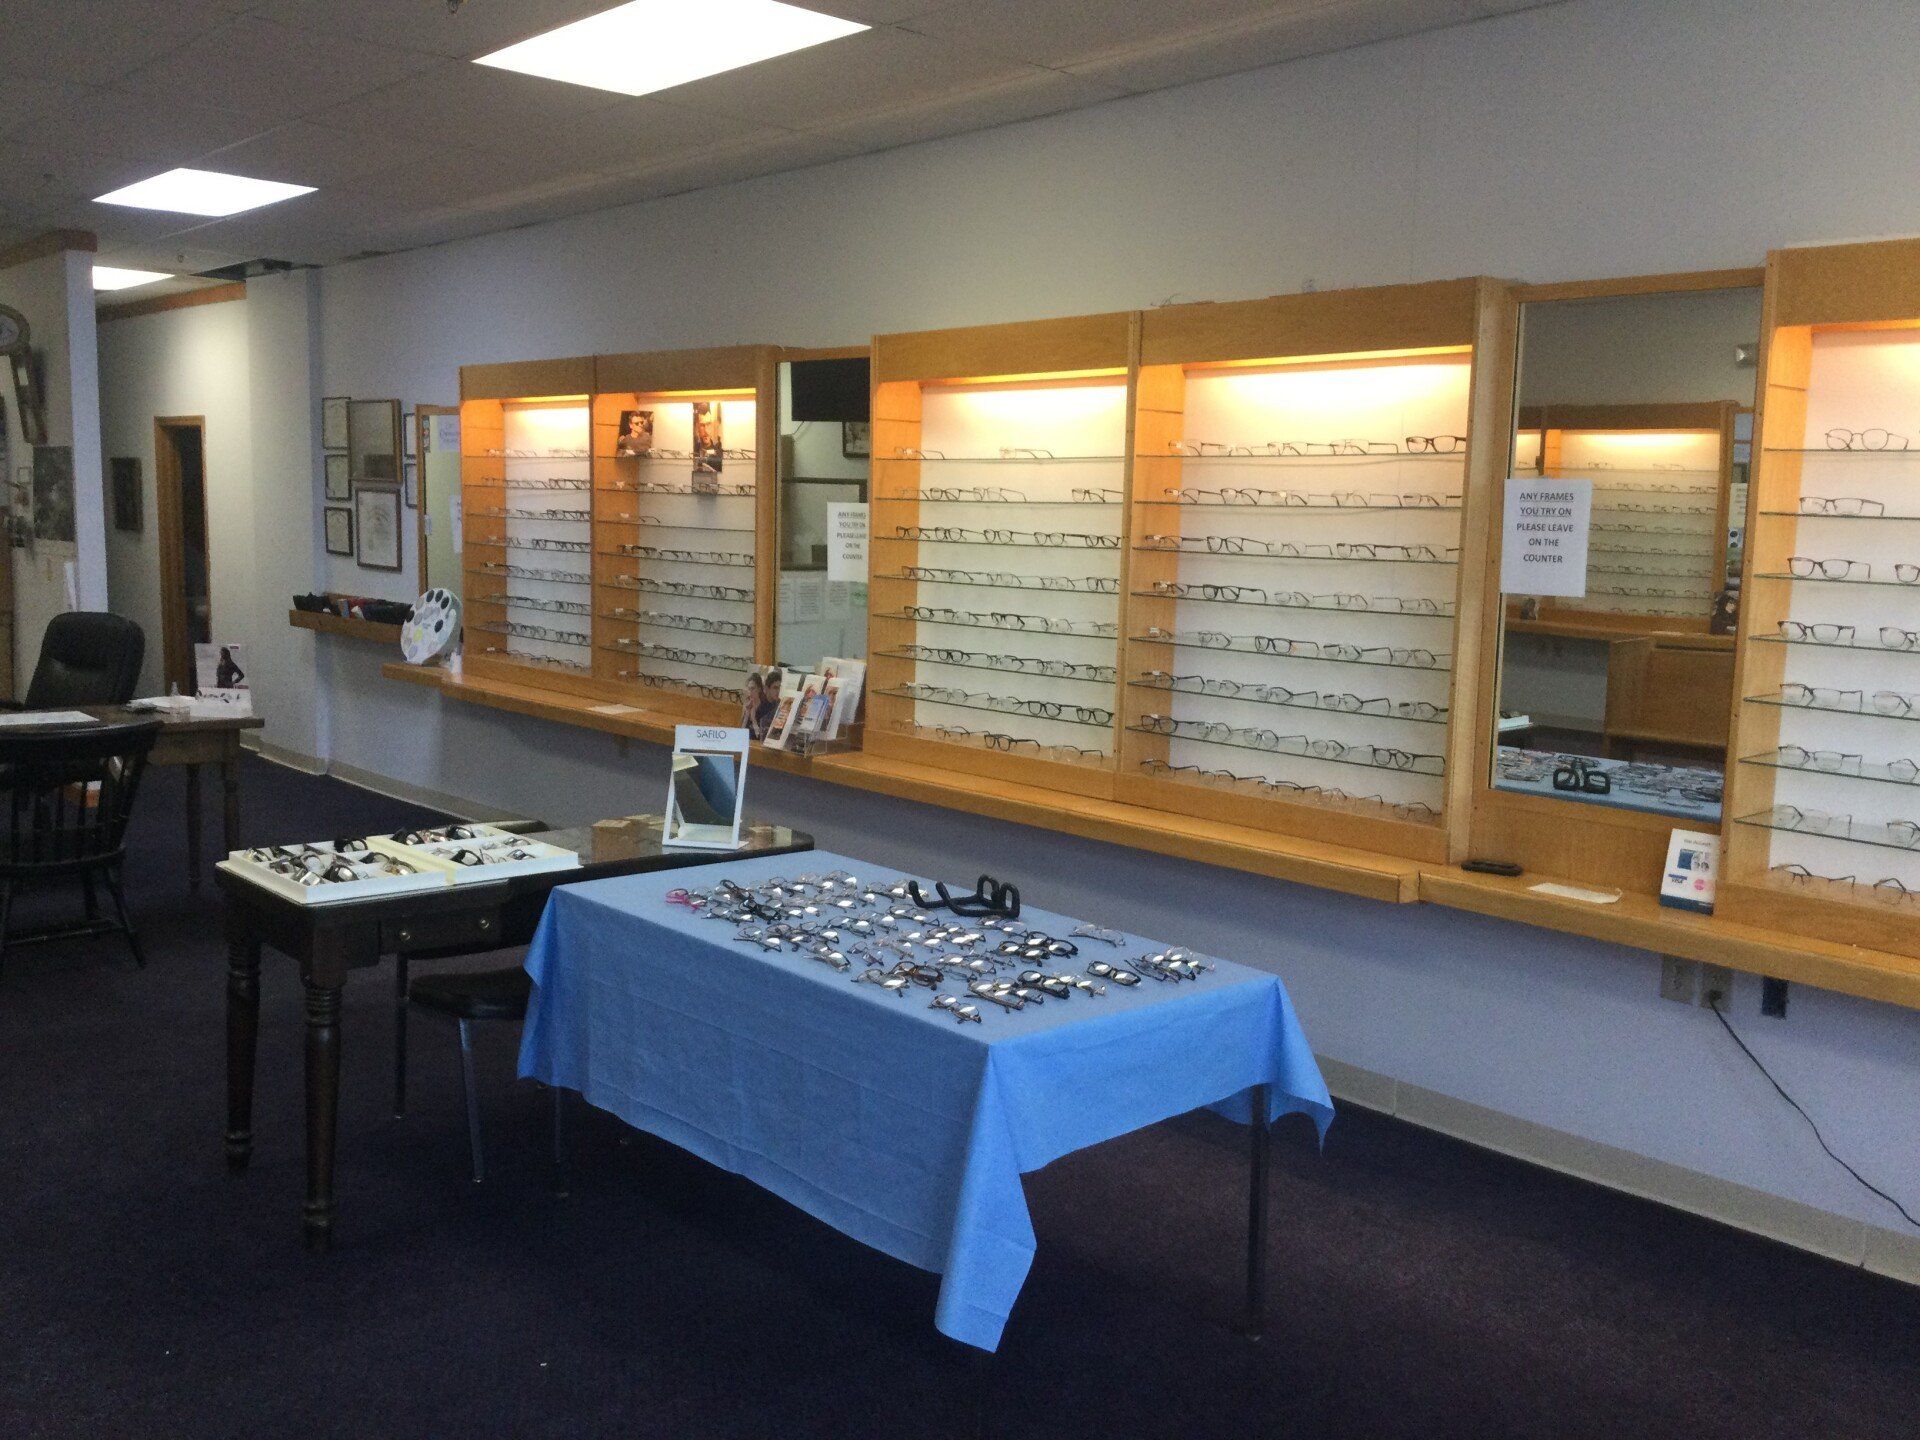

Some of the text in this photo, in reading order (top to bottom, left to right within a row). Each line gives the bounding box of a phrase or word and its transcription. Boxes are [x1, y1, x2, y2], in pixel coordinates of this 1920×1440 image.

[1520, 492, 1574, 502] ANY FRAMES
[1520, 507, 1572, 516] YOU TRY ON
[1516, 523, 1574, 533] PLEASE LEAVE
[1528, 538, 1559, 547] ON THE
[1523, 554, 1563, 563] COUNTER
[697, 729, 727, 739] SAFILO
